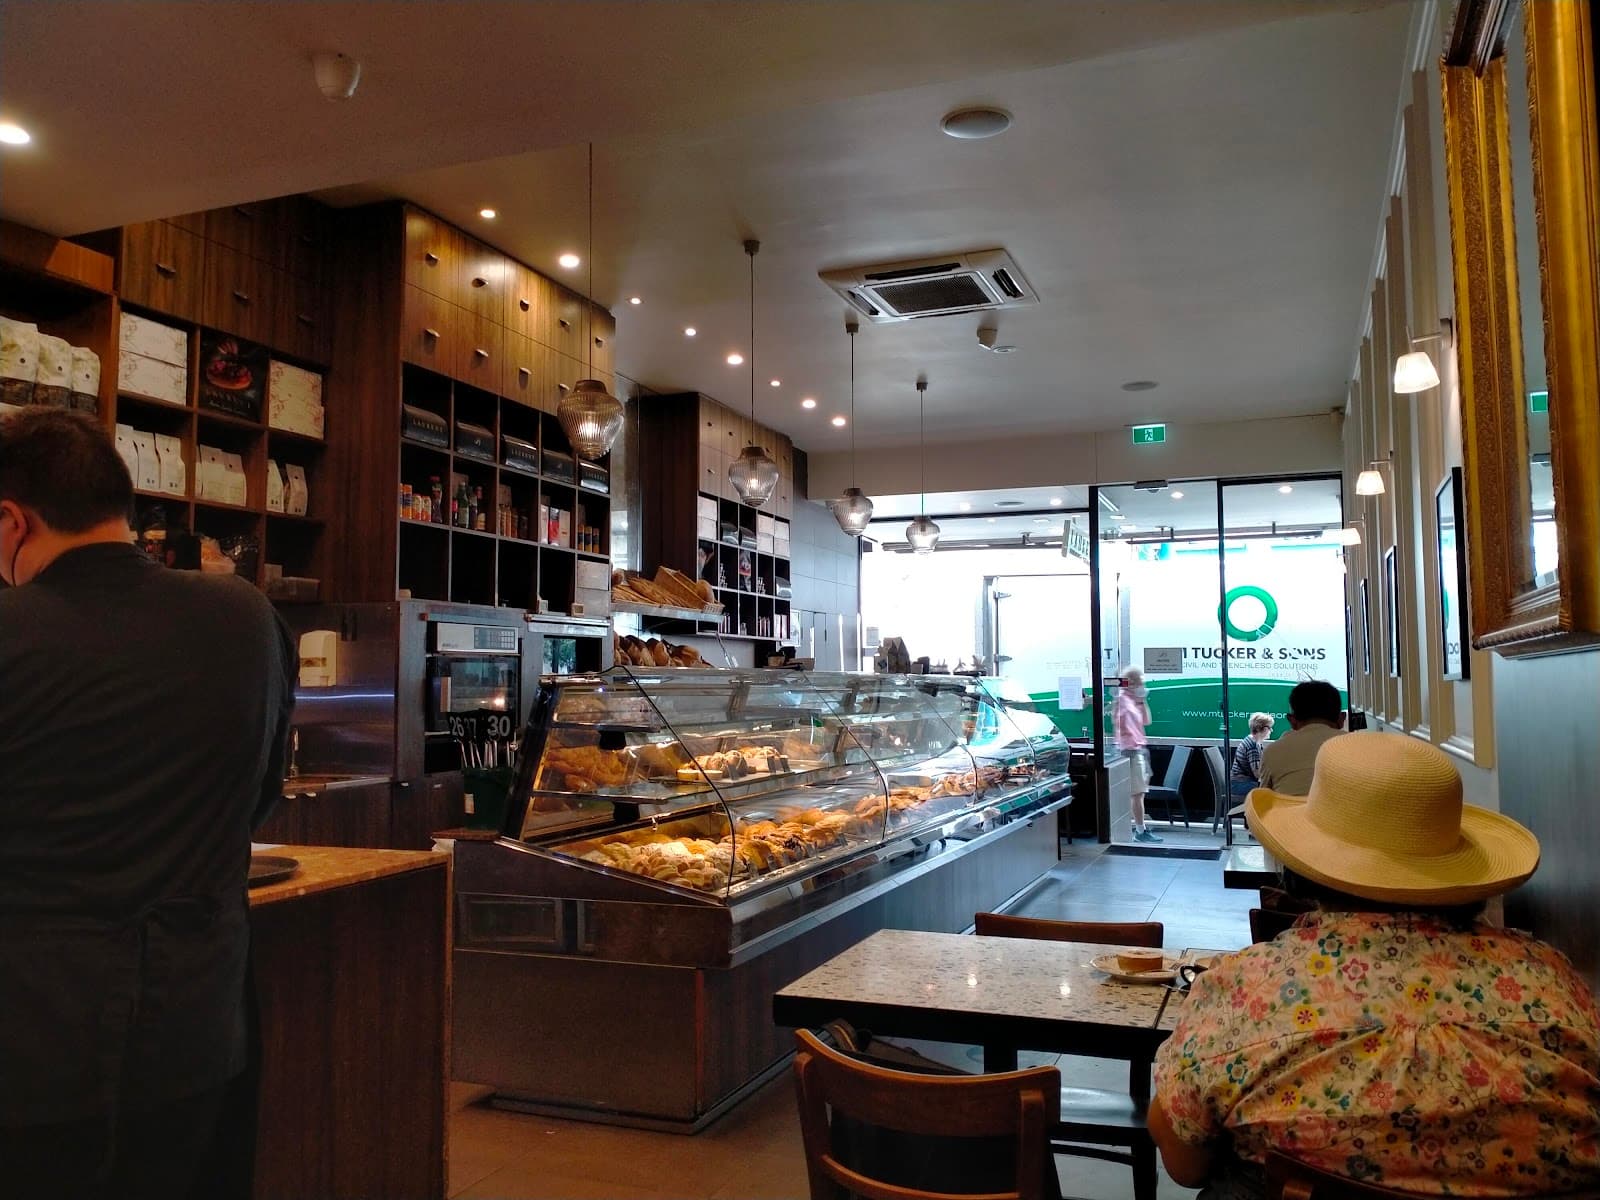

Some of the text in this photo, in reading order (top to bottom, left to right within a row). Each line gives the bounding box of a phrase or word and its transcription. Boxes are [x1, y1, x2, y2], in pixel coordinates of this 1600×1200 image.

[1191, 647, 1257, 660] TUCKER
[1262, 647, 1274, 660] &
[487, 715, 511, 737] 30
